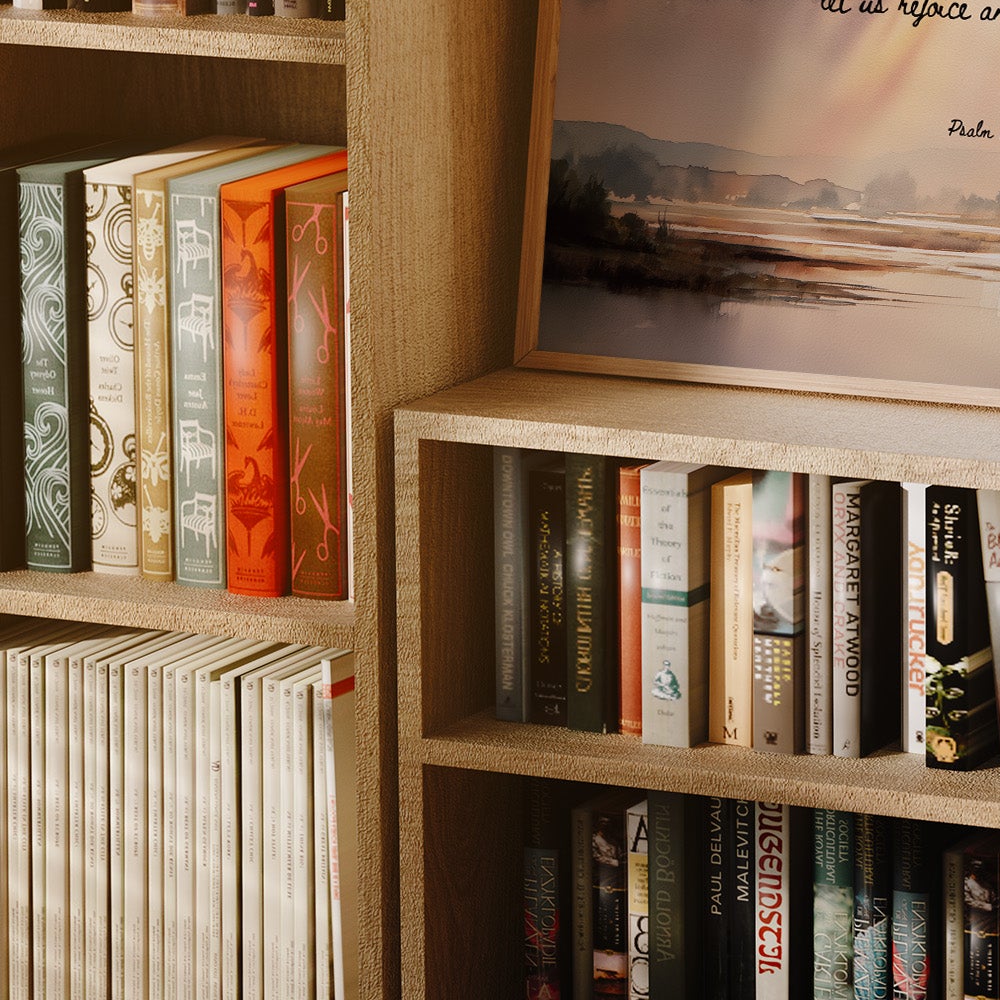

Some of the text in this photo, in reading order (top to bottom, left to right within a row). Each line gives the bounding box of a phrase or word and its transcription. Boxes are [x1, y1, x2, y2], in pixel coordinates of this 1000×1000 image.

[948, 119, 994, 140] Psalm
[834, 492, 846, 669] ORYX AND CRAKE
[846, 493, 860, 697] MARGARET ATWOOD
[711, 871, 722, 915] PAUL
